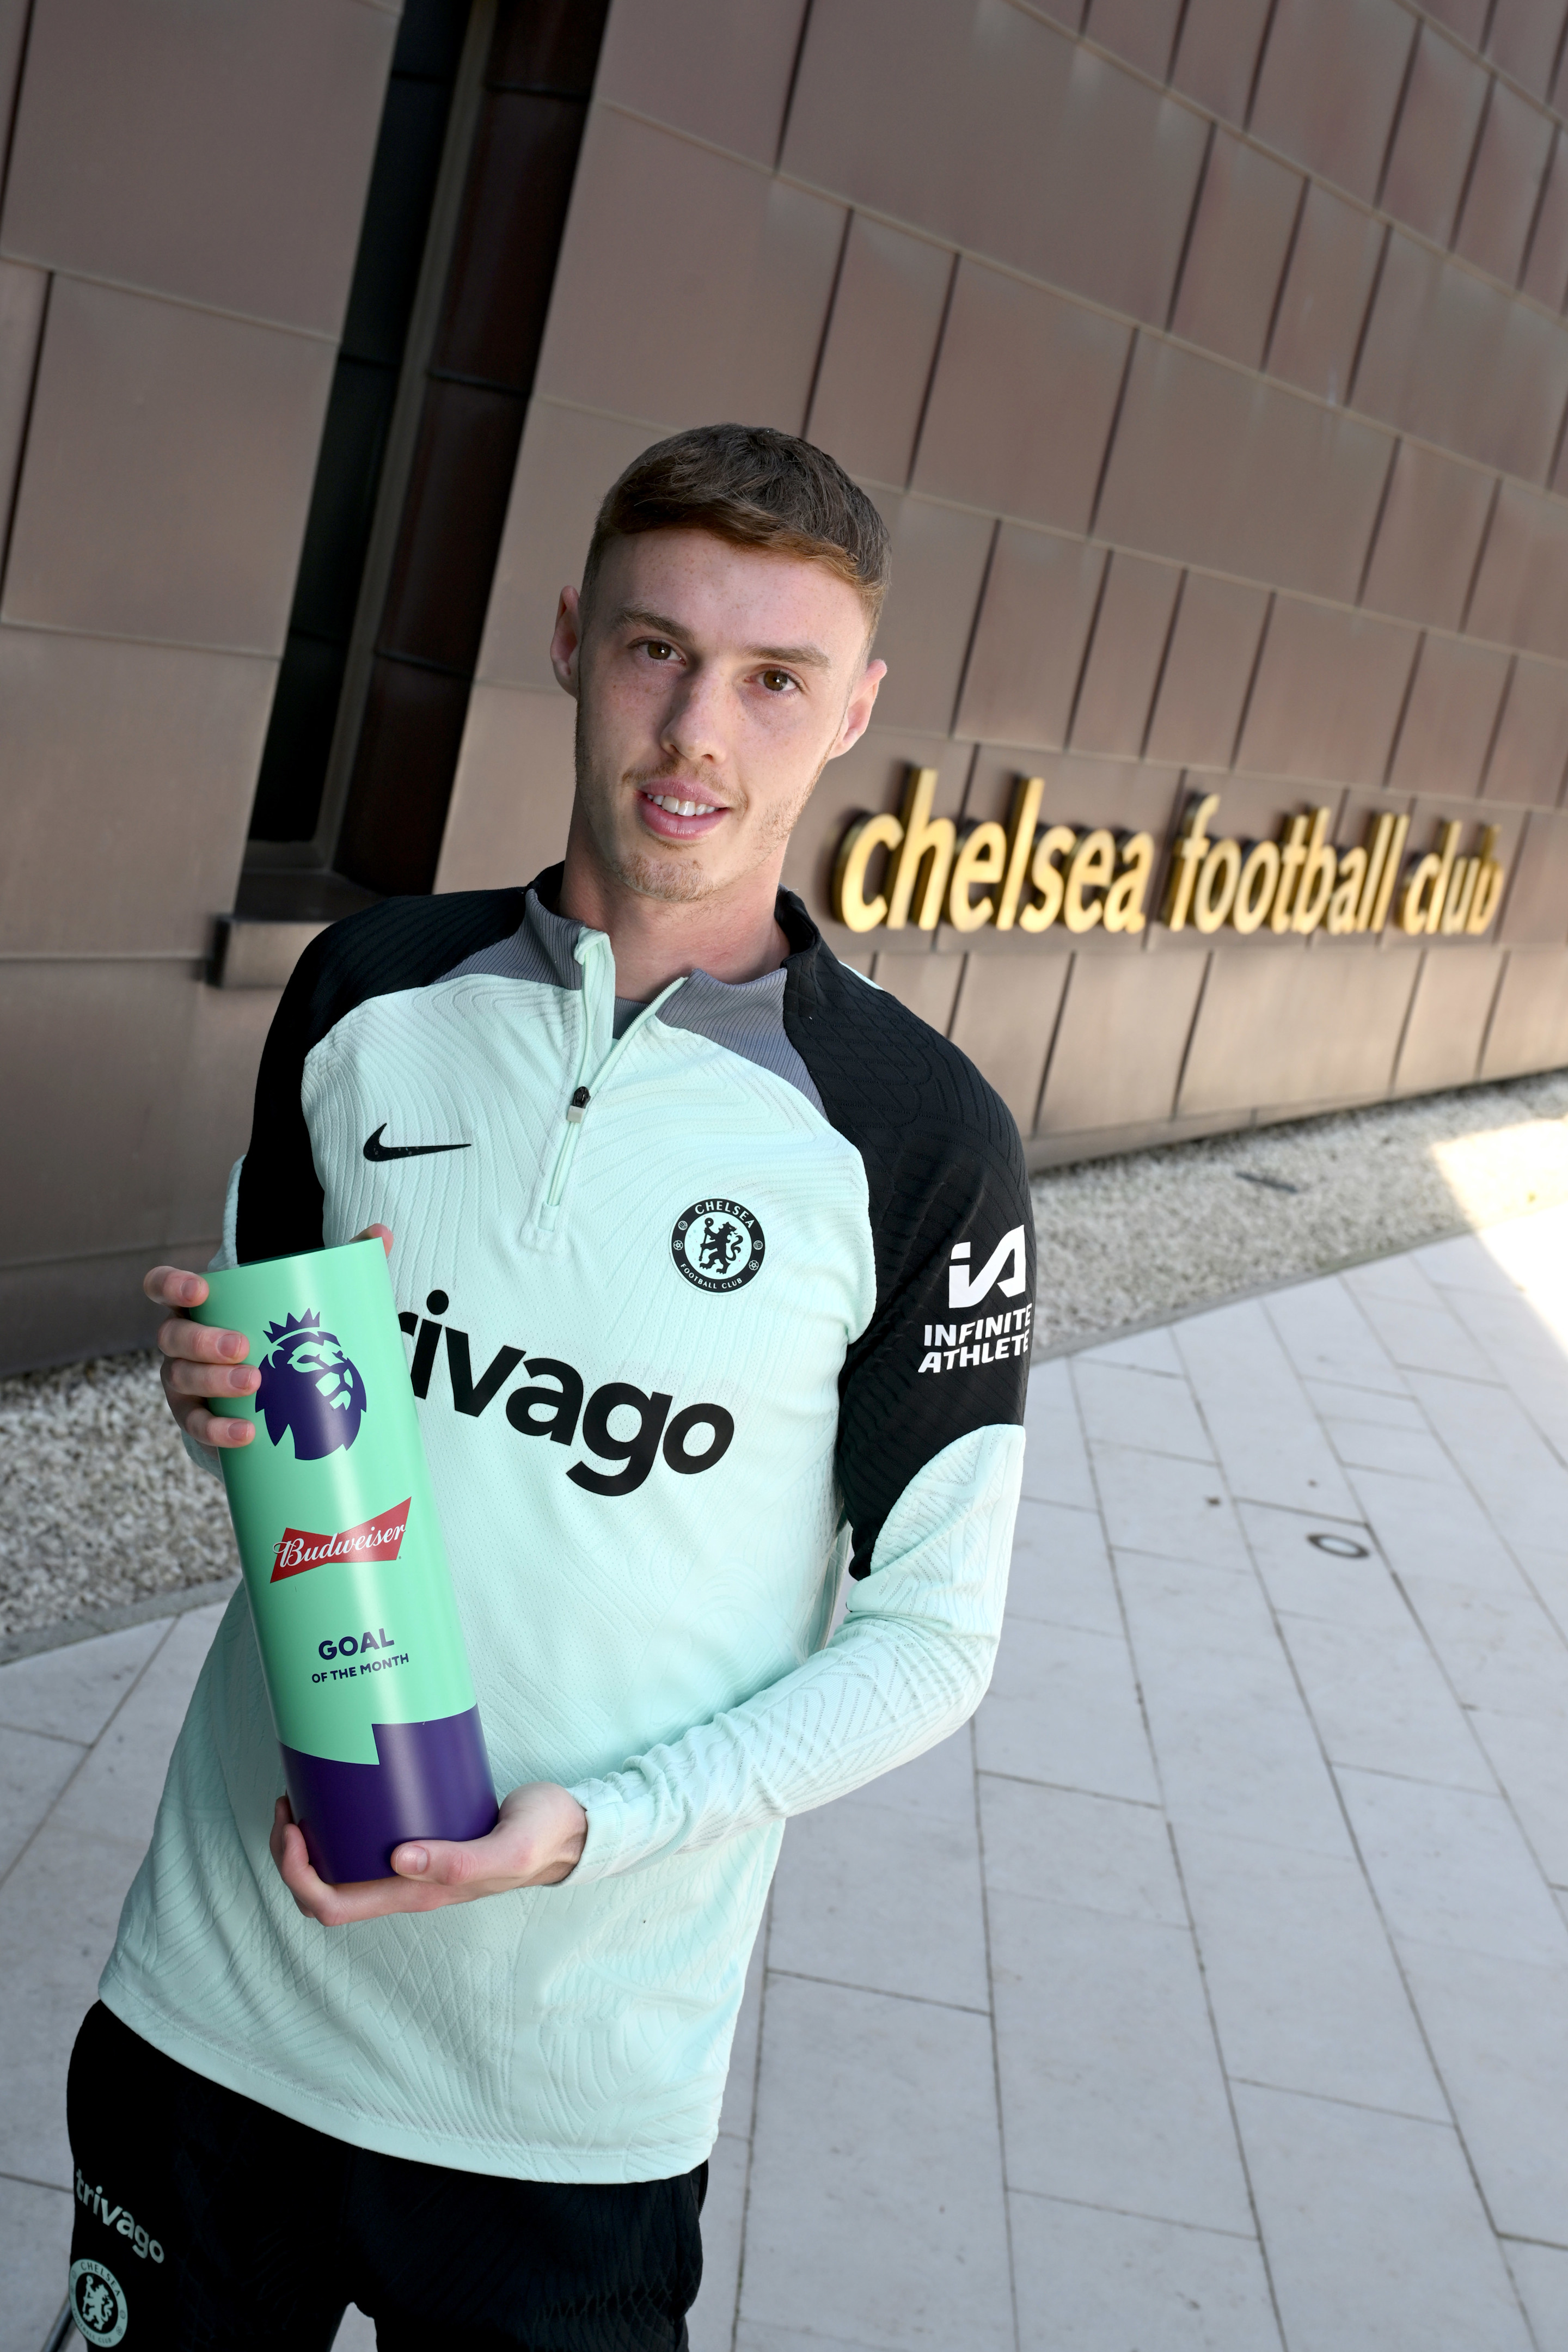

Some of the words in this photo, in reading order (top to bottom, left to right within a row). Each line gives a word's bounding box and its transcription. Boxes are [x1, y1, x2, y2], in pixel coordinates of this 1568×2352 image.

[833, 767, 1154, 933] chelsea
[1165, 794, 1409, 934] football
[1398, 820, 1504, 935] club
[695, 1200, 755, 1228] CHELSEA
[681, 1263, 717, 1289] FOOTBALL
[721, 1277, 743, 1289] CLUB
[924, 1303, 1032, 1346] INFINITE
[918, 1329, 1030, 1373] ATHLETE
[398, 1289, 734, 1496] ivago
[273, 1524, 405, 1567] Budweiser
[318, 1628, 395, 1660] GOAL
[311, 1672, 328, 1683] OF
[330, 1667, 357, 1680] THE
[360, 1653, 409, 1675] MONTH
[76, 2169, 164, 2264] trivago
[81, 2262, 121, 2296] CHELSEA
